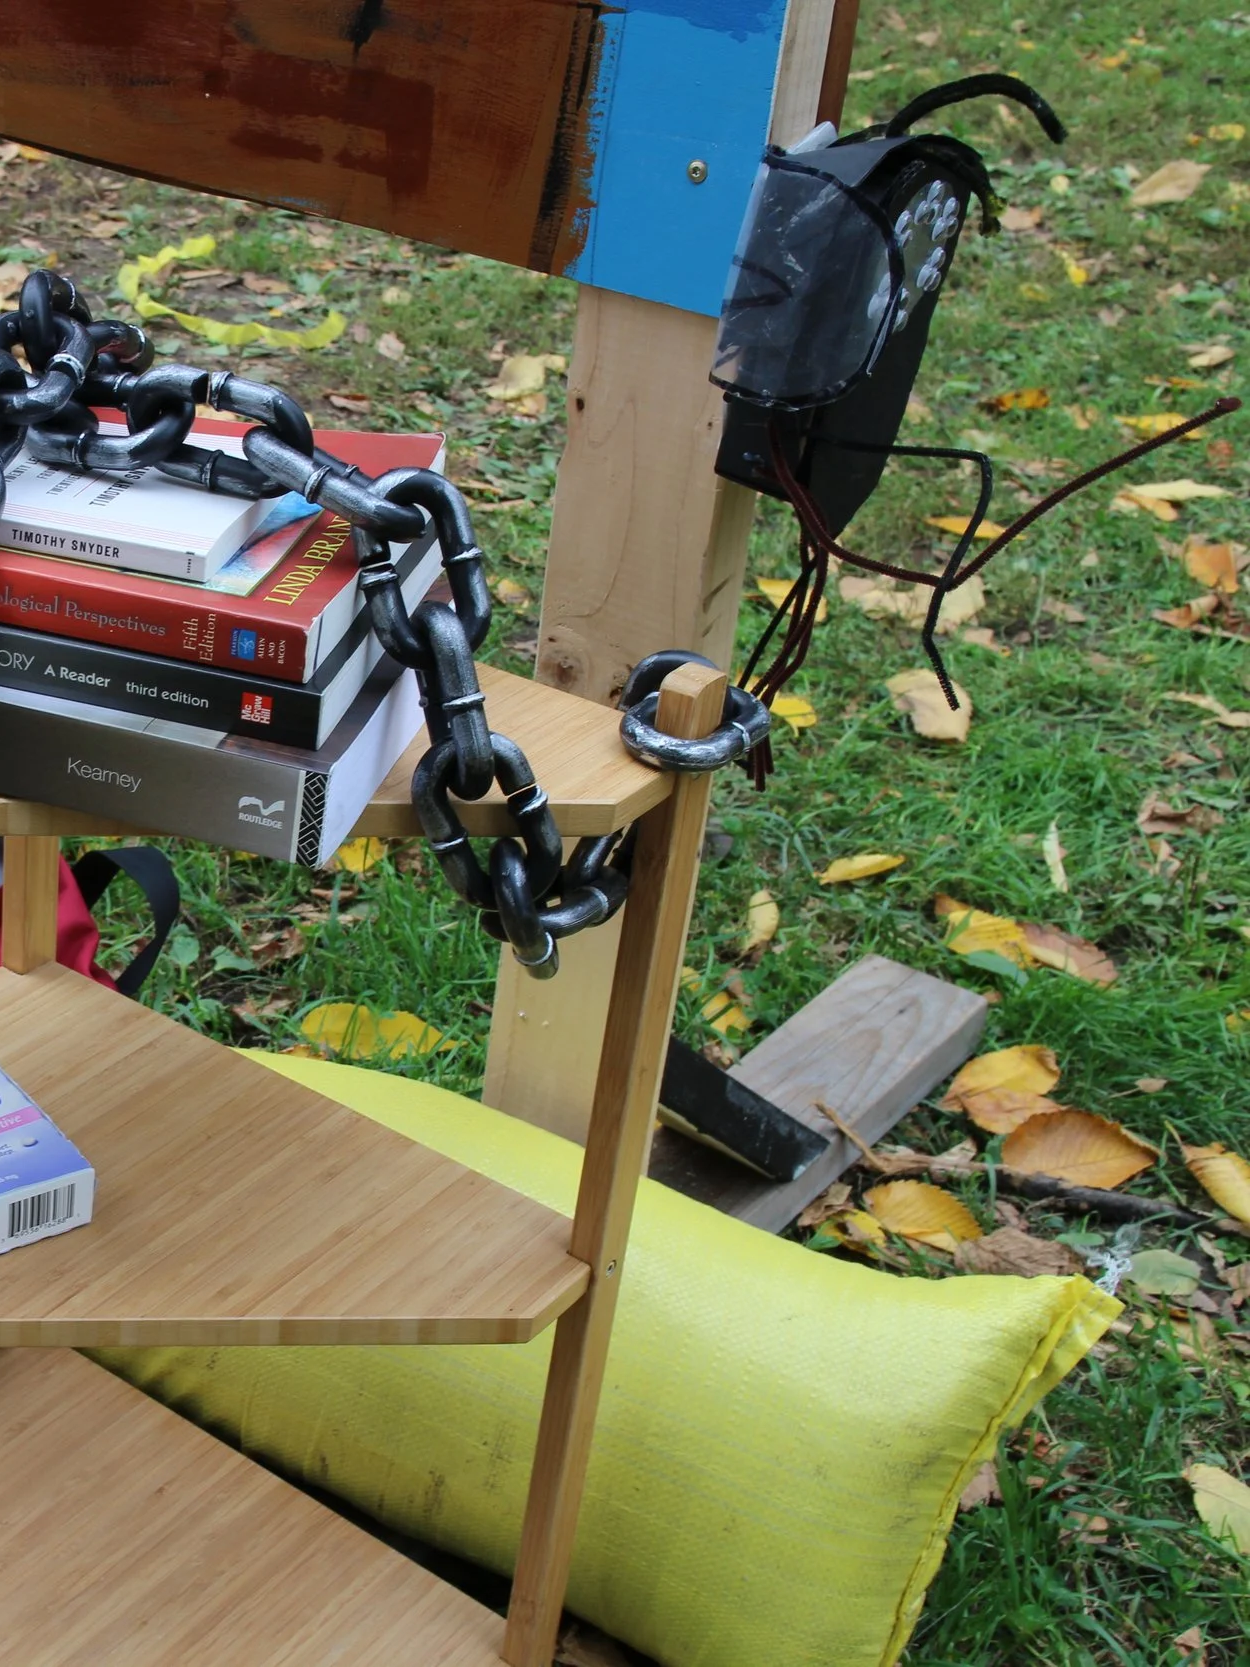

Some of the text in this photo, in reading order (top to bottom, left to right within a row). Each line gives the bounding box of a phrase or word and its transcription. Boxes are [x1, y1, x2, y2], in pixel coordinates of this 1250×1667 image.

[88, 479, 135, 507] TIMOTHY
[12, 529, 66, 548] TIMOTHY
[71, 540, 120, 558] SNYDER
[263, 515, 352, 606] LINDA BRAN
[65, 600, 166, 636] Perspectives
[182, 617, 199, 650] Fifth
[198, 613, 216, 661] Edition
[258, 637, 266, 658] ALLYN
[268, 641, 276, 658] AND
[277, 639, 286, 665] BACON
[44, 664, 56, 677] A
[59, 666, 111, 688] Reader
[126, 681, 158, 698] third
[161, 690, 210, 709] edition
[241, 704, 252, 721] Mc
[251, 695, 263, 723] Graw
[260, 708, 271, 725] Hill
[67, 757, 142, 793] Kearney
[238, 812, 283, 829] ROUTLEDGE
